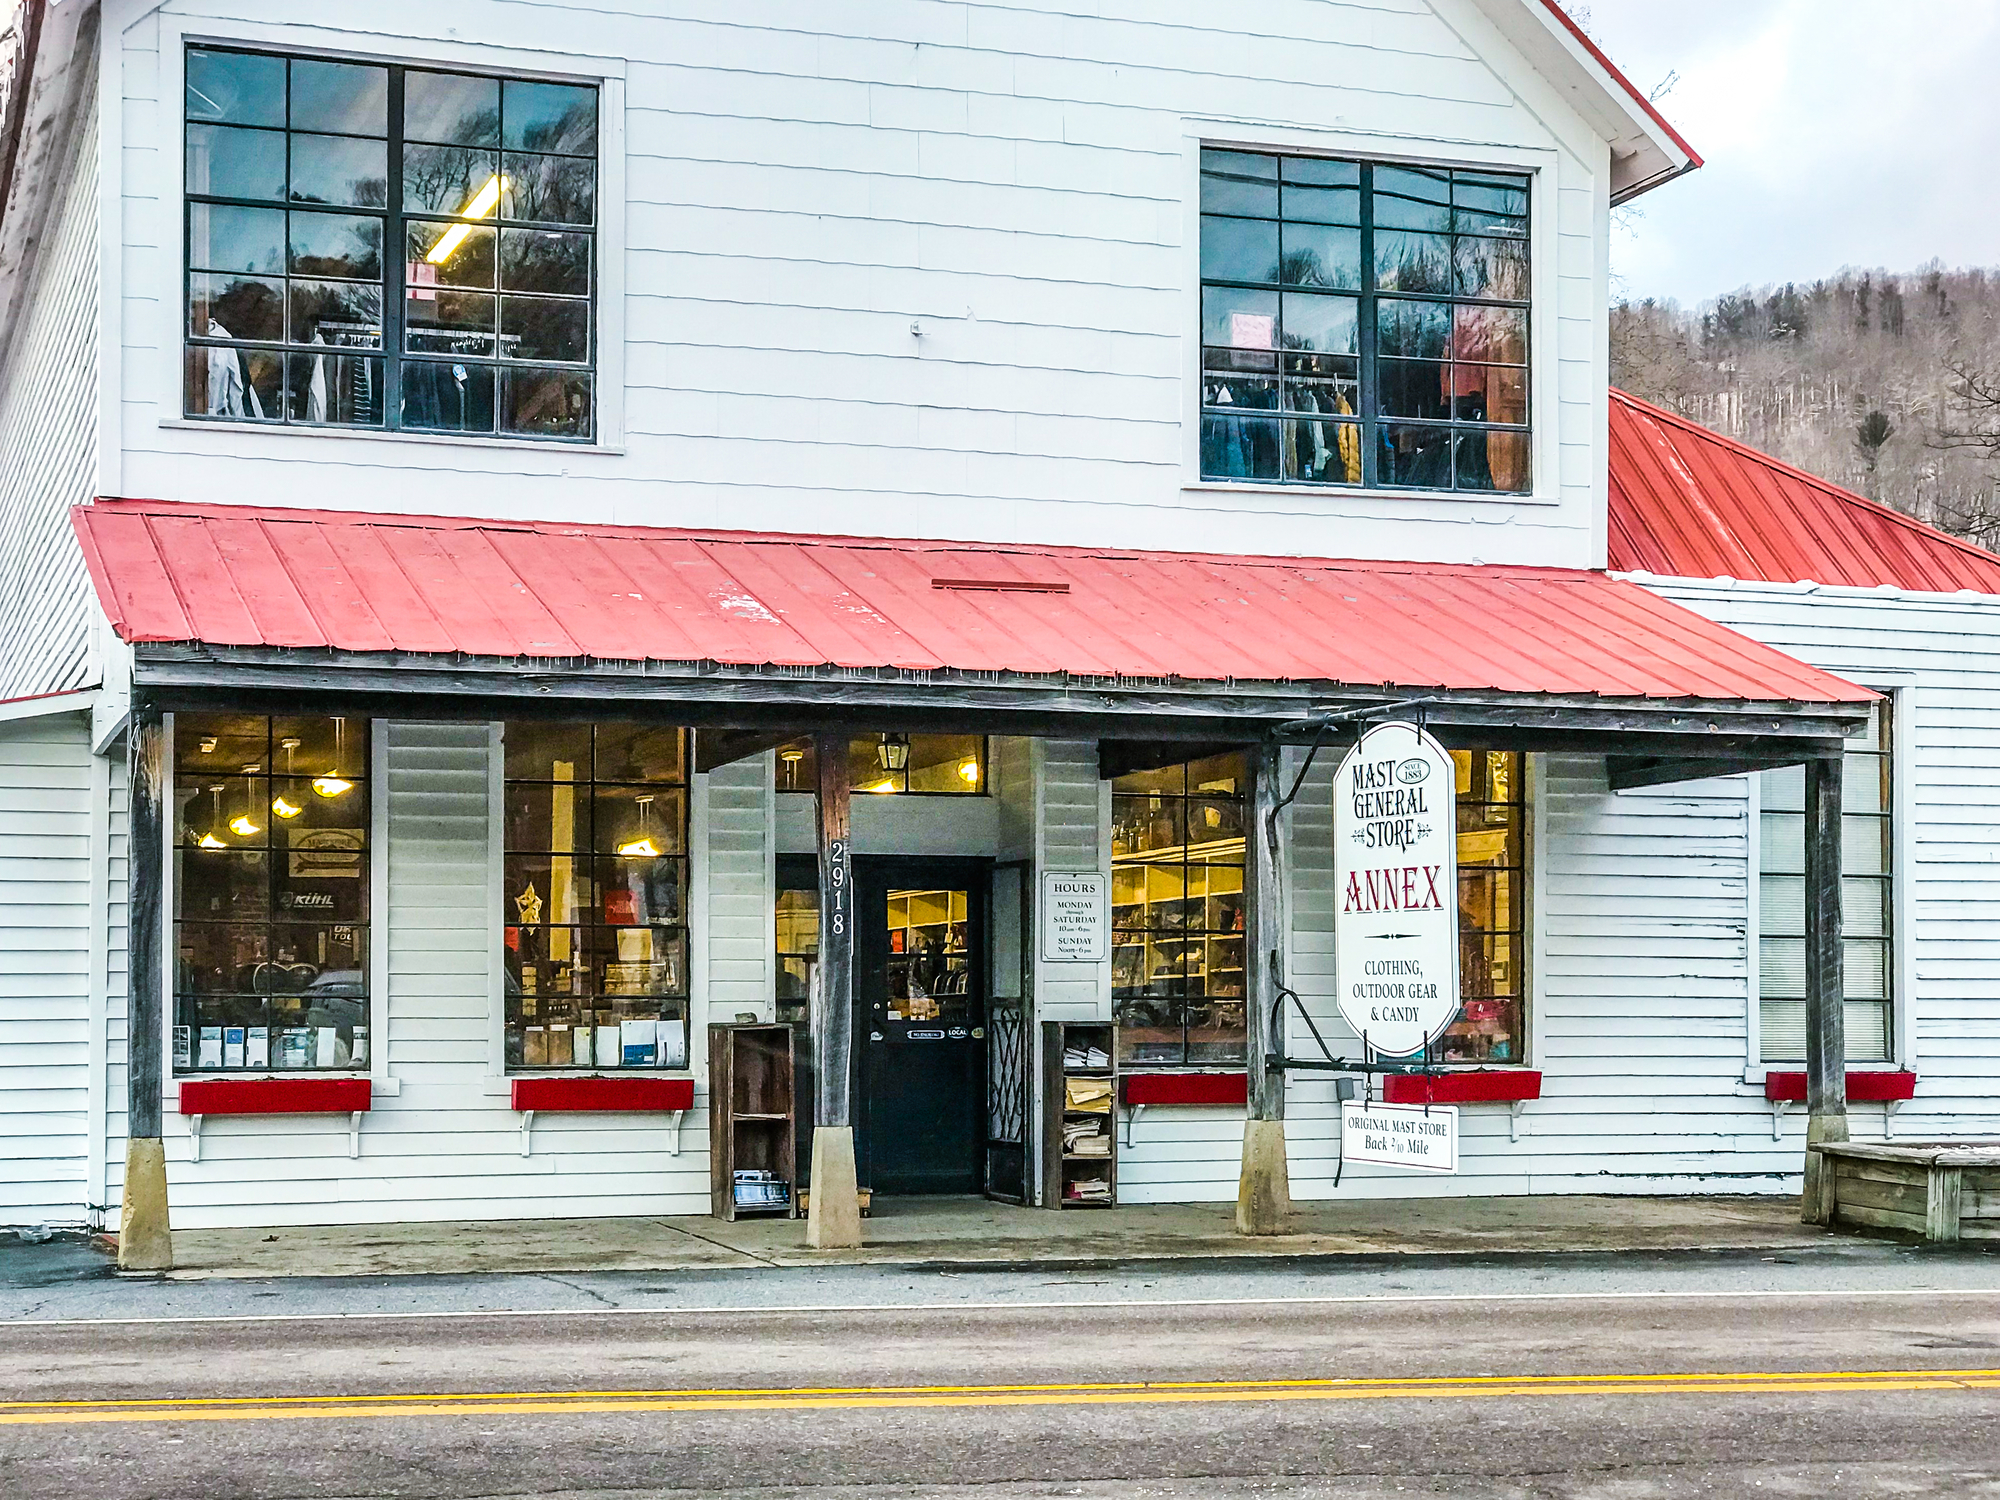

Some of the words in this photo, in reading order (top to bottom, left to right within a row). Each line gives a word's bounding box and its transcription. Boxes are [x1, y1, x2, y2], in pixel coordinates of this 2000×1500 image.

[1404, 763, 1421, 771] SINCE
[1352, 760, 1396, 799] MAST
[1404, 770, 1422, 781] 1883
[1354, 787, 1428, 819] GENERAL
[1366, 819, 1415, 854] STORE
[831, 842, 844, 935] 2918
[1054, 883, 1096, 893] HOURS
[1344, 865, 1443, 913] ANNEX
[294, 892, 334, 905] KÜHL
[1057, 901, 1093, 909] MONDAY
[1053, 916, 1097, 924] SATURDAY
[1058, 937, 1092, 945] SUNDAY
[1364, 960, 1423, 979] CLOTHING,
[1352, 983, 1405, 998] OUTDOOR
[1408, 983, 1438, 999] GEAR
[1370, 1006, 1379, 1021] &
[1382, 1006, 1419, 1022] CANDY
[1348, 1116, 1389, 1132] ORIGINAL
[1392, 1120, 1415, 1134] MAST
[1418, 1122, 1447, 1137] STORE
[1365, 1135, 1387, 1151] Back
[1407, 1138, 1429, 1154] Mile
